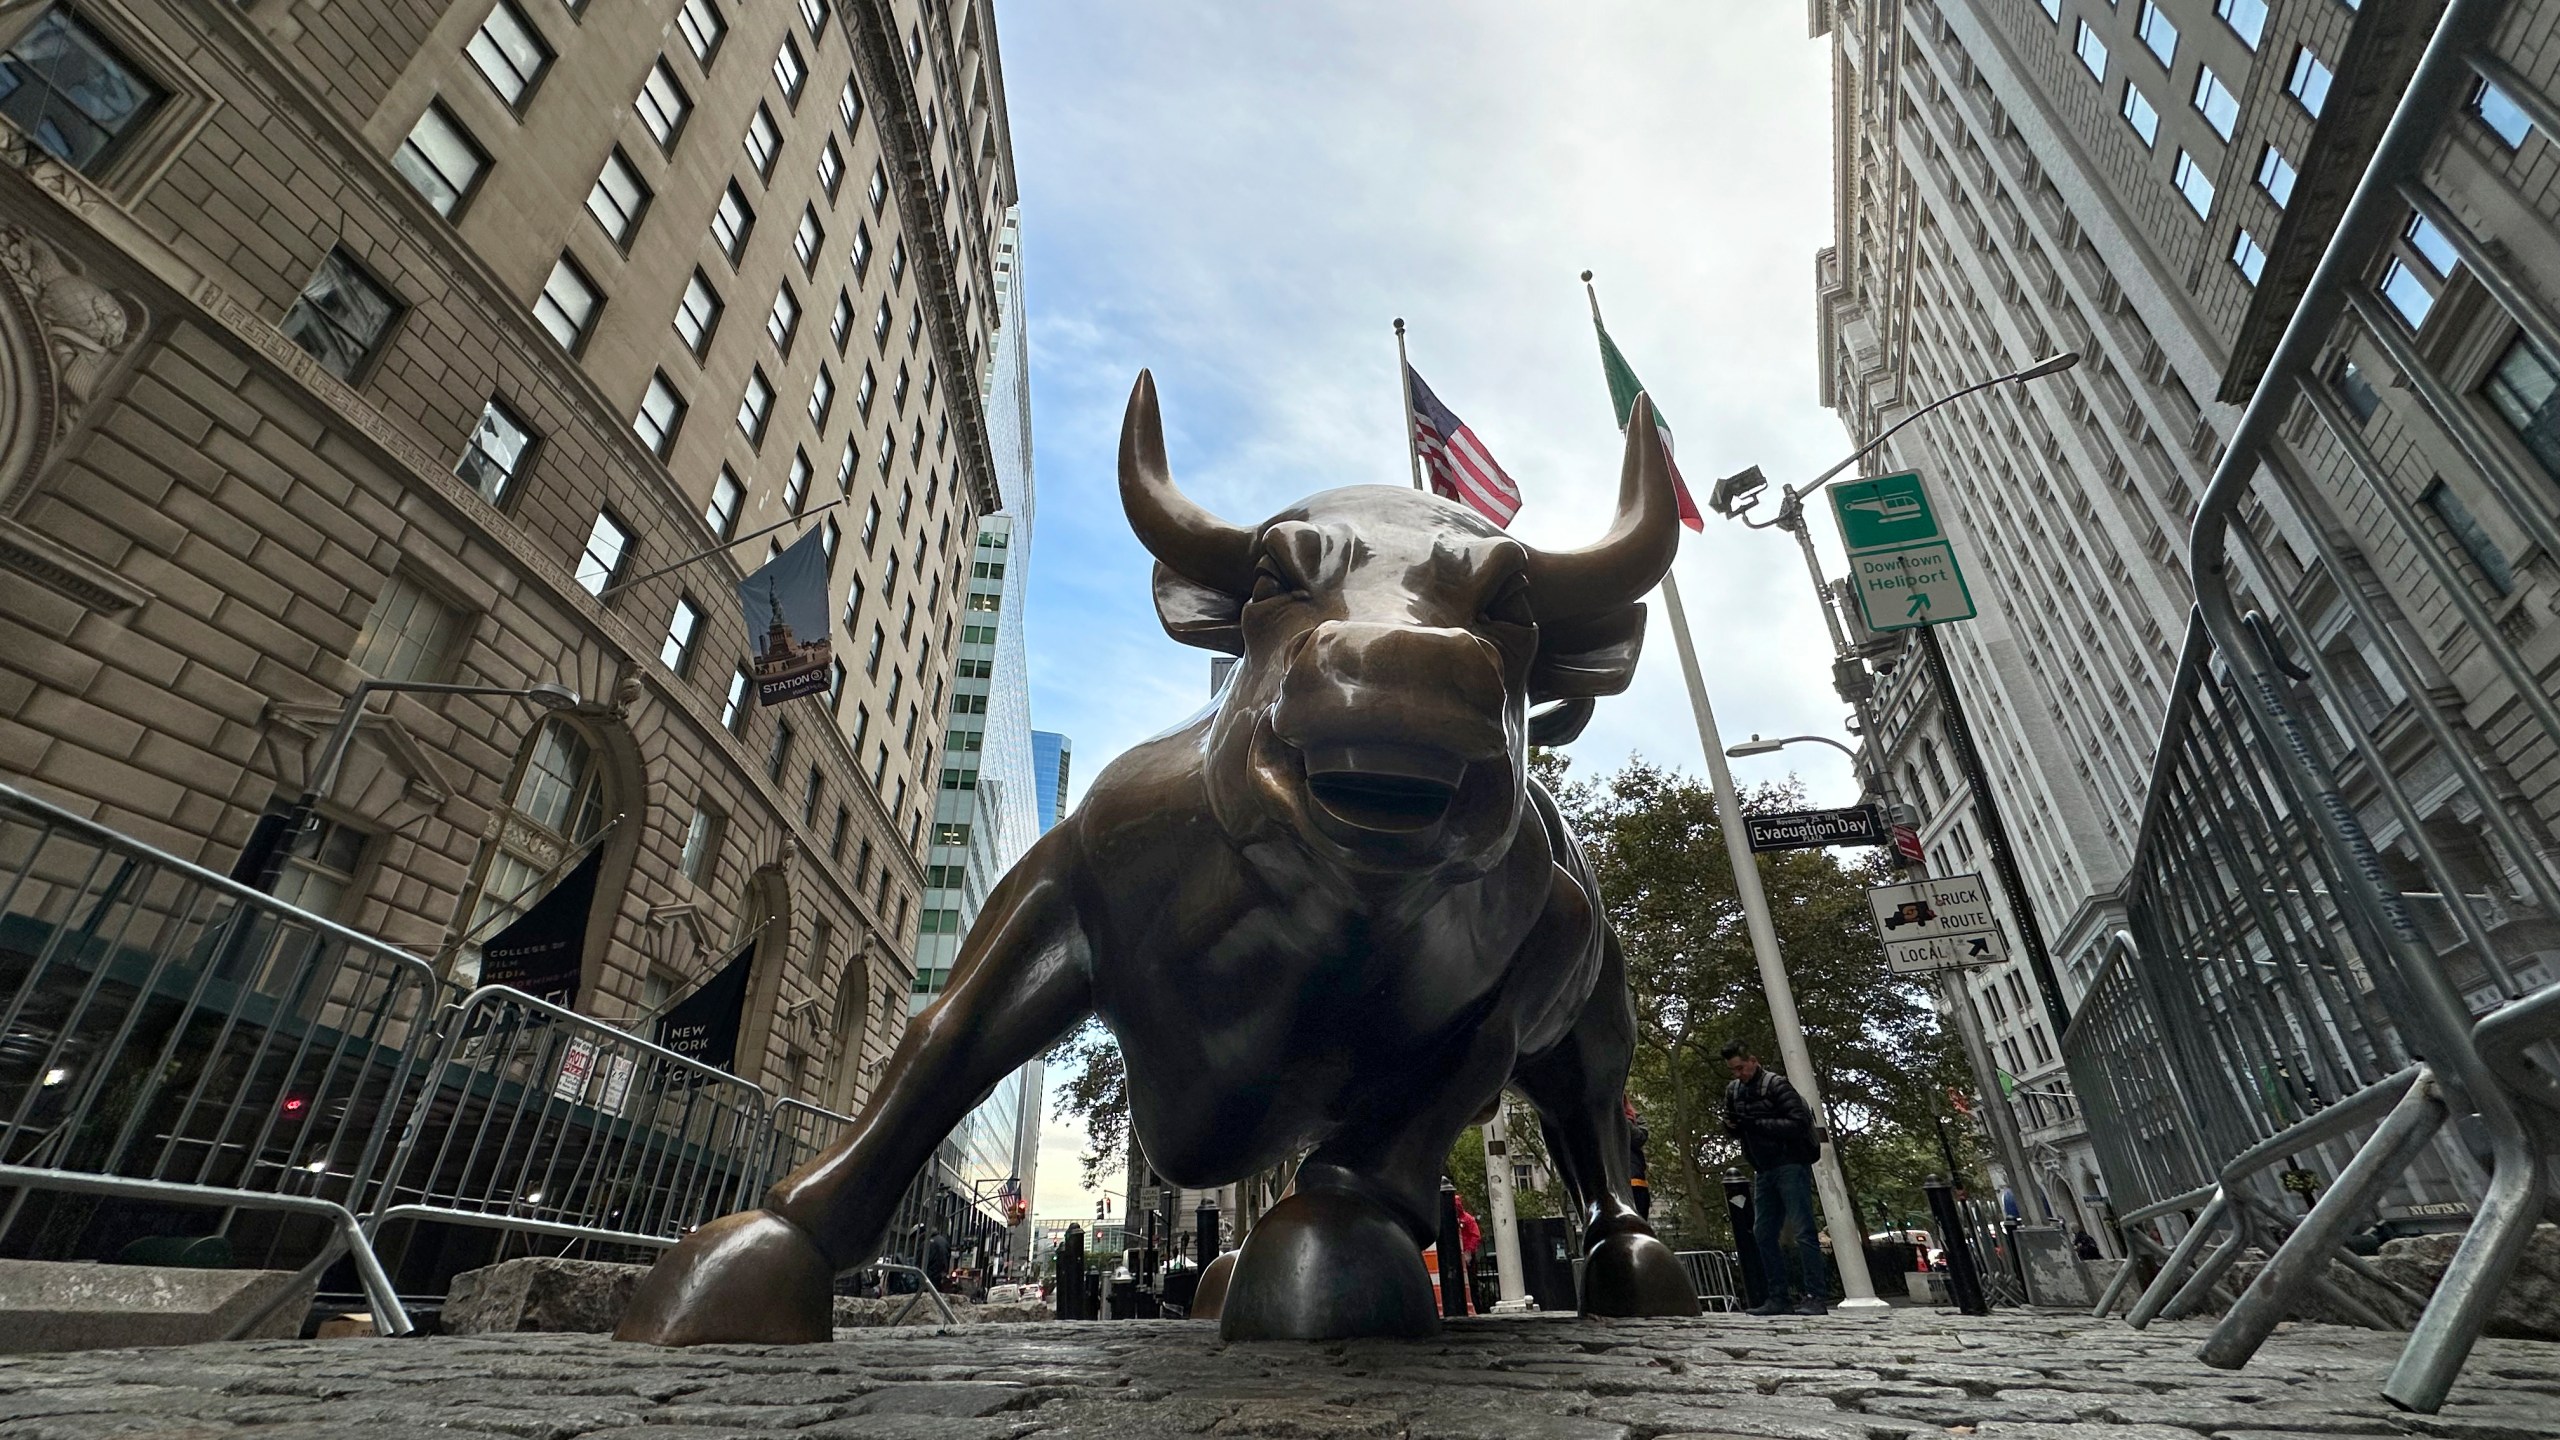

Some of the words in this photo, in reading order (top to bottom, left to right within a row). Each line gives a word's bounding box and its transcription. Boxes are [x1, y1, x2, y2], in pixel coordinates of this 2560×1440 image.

[1863, 554, 1942, 574] Downtown
[1868, 569, 1948, 592] Heliport
[763, 674, 810, 694] STATION
[1754, 822, 1836, 841] Evacuation
[1838, 819, 1867, 835] Day
[1802, 834, 1824, 842] PLAZA
[1933, 890, 1979, 906] TRUCK
[1940, 912, 1987, 929] ROUTE
[490, 945, 547, 958] COLLEGE
[1900, 946, 1947, 963] LOCAL
[489, 960, 518, 969] FILM
[487, 970, 526, 980] MEDIA
[671, 1025, 706, 1039] NEW
[670, 1038, 709, 1051] YORK
